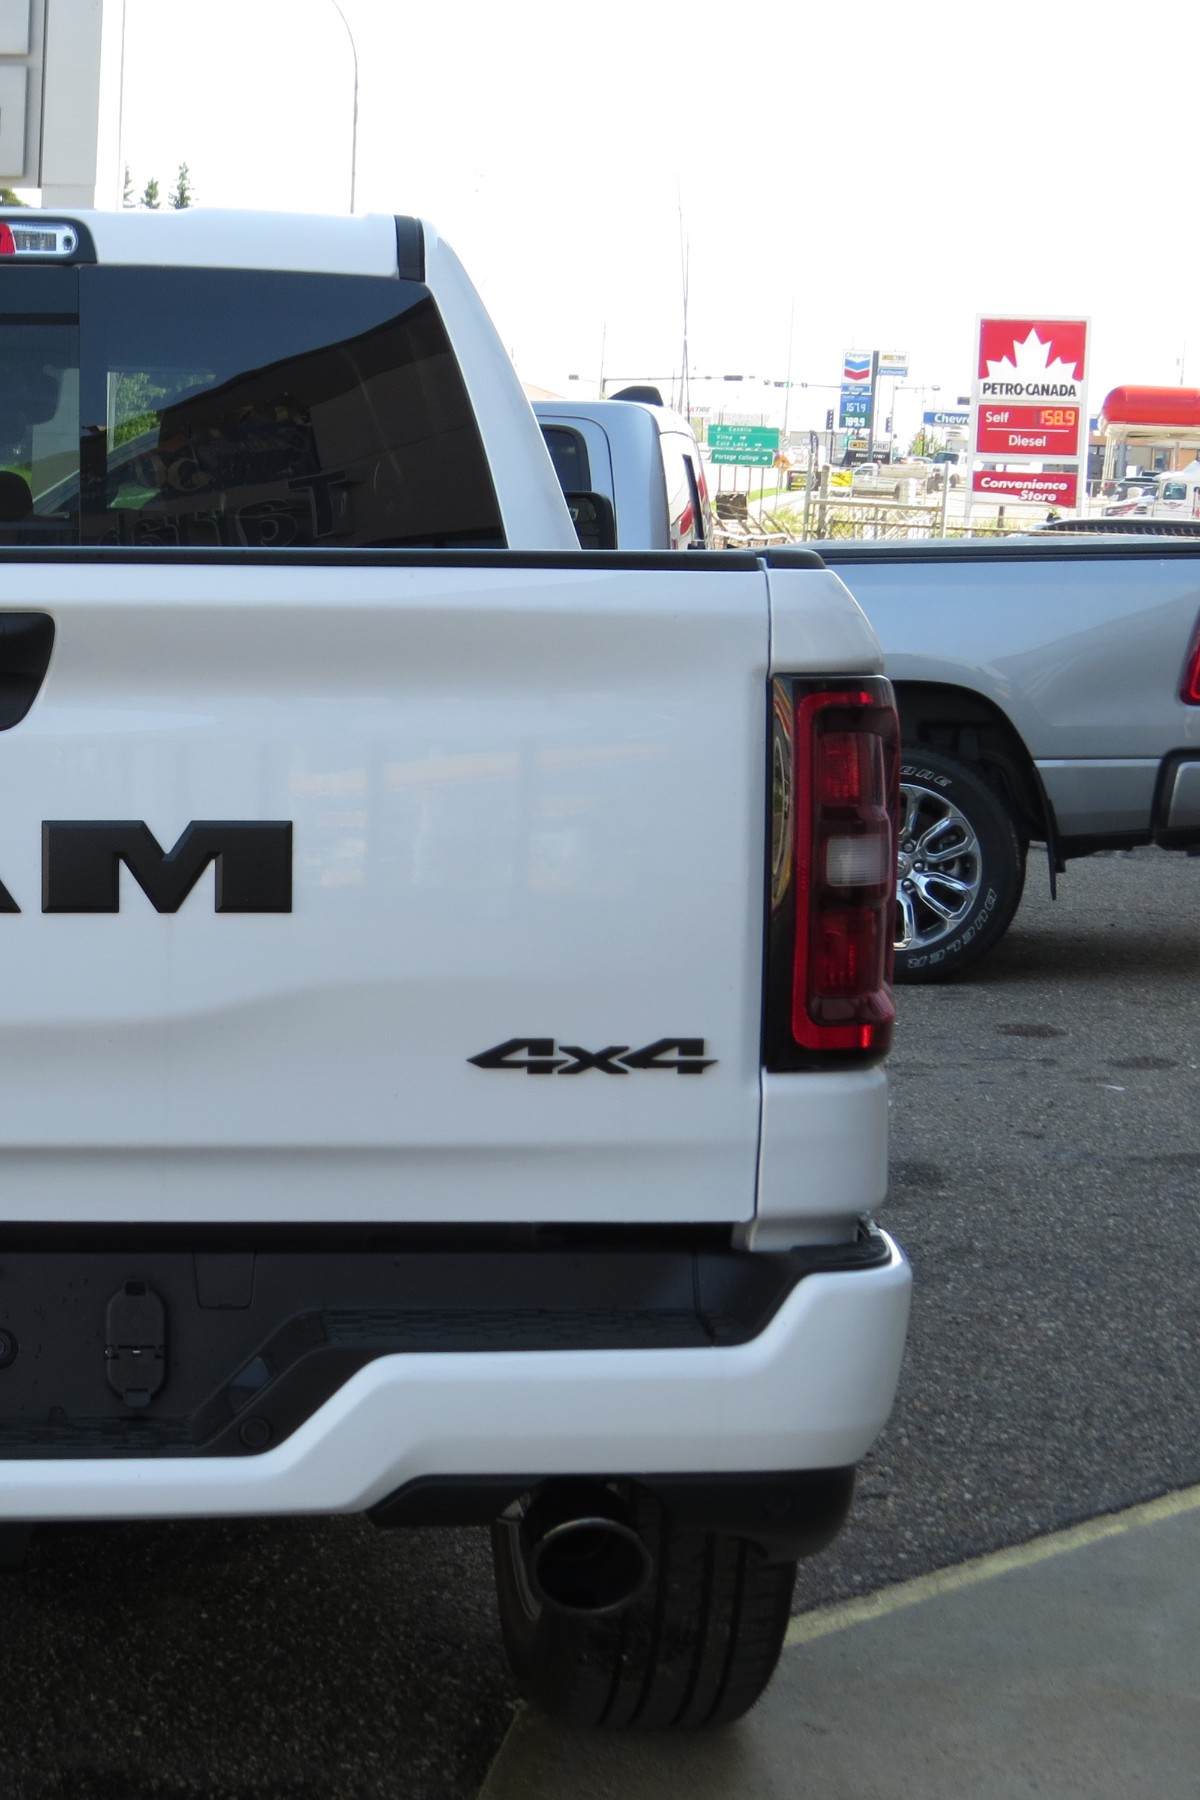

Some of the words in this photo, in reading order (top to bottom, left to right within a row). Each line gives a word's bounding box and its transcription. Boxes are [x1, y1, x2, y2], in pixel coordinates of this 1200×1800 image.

[985, 411, 1009, 423] Self
[1041, 409, 1075, 426] 158.9
[1008, 434, 1047, 447] Diesel
[714, 453, 737, 462] Portage
[738, 453, 759, 462] College
[980, 477, 1068, 490] Convenience
[1019, 489, 1057, 502] Store
[466, 1038, 719, 1074] 4x4
